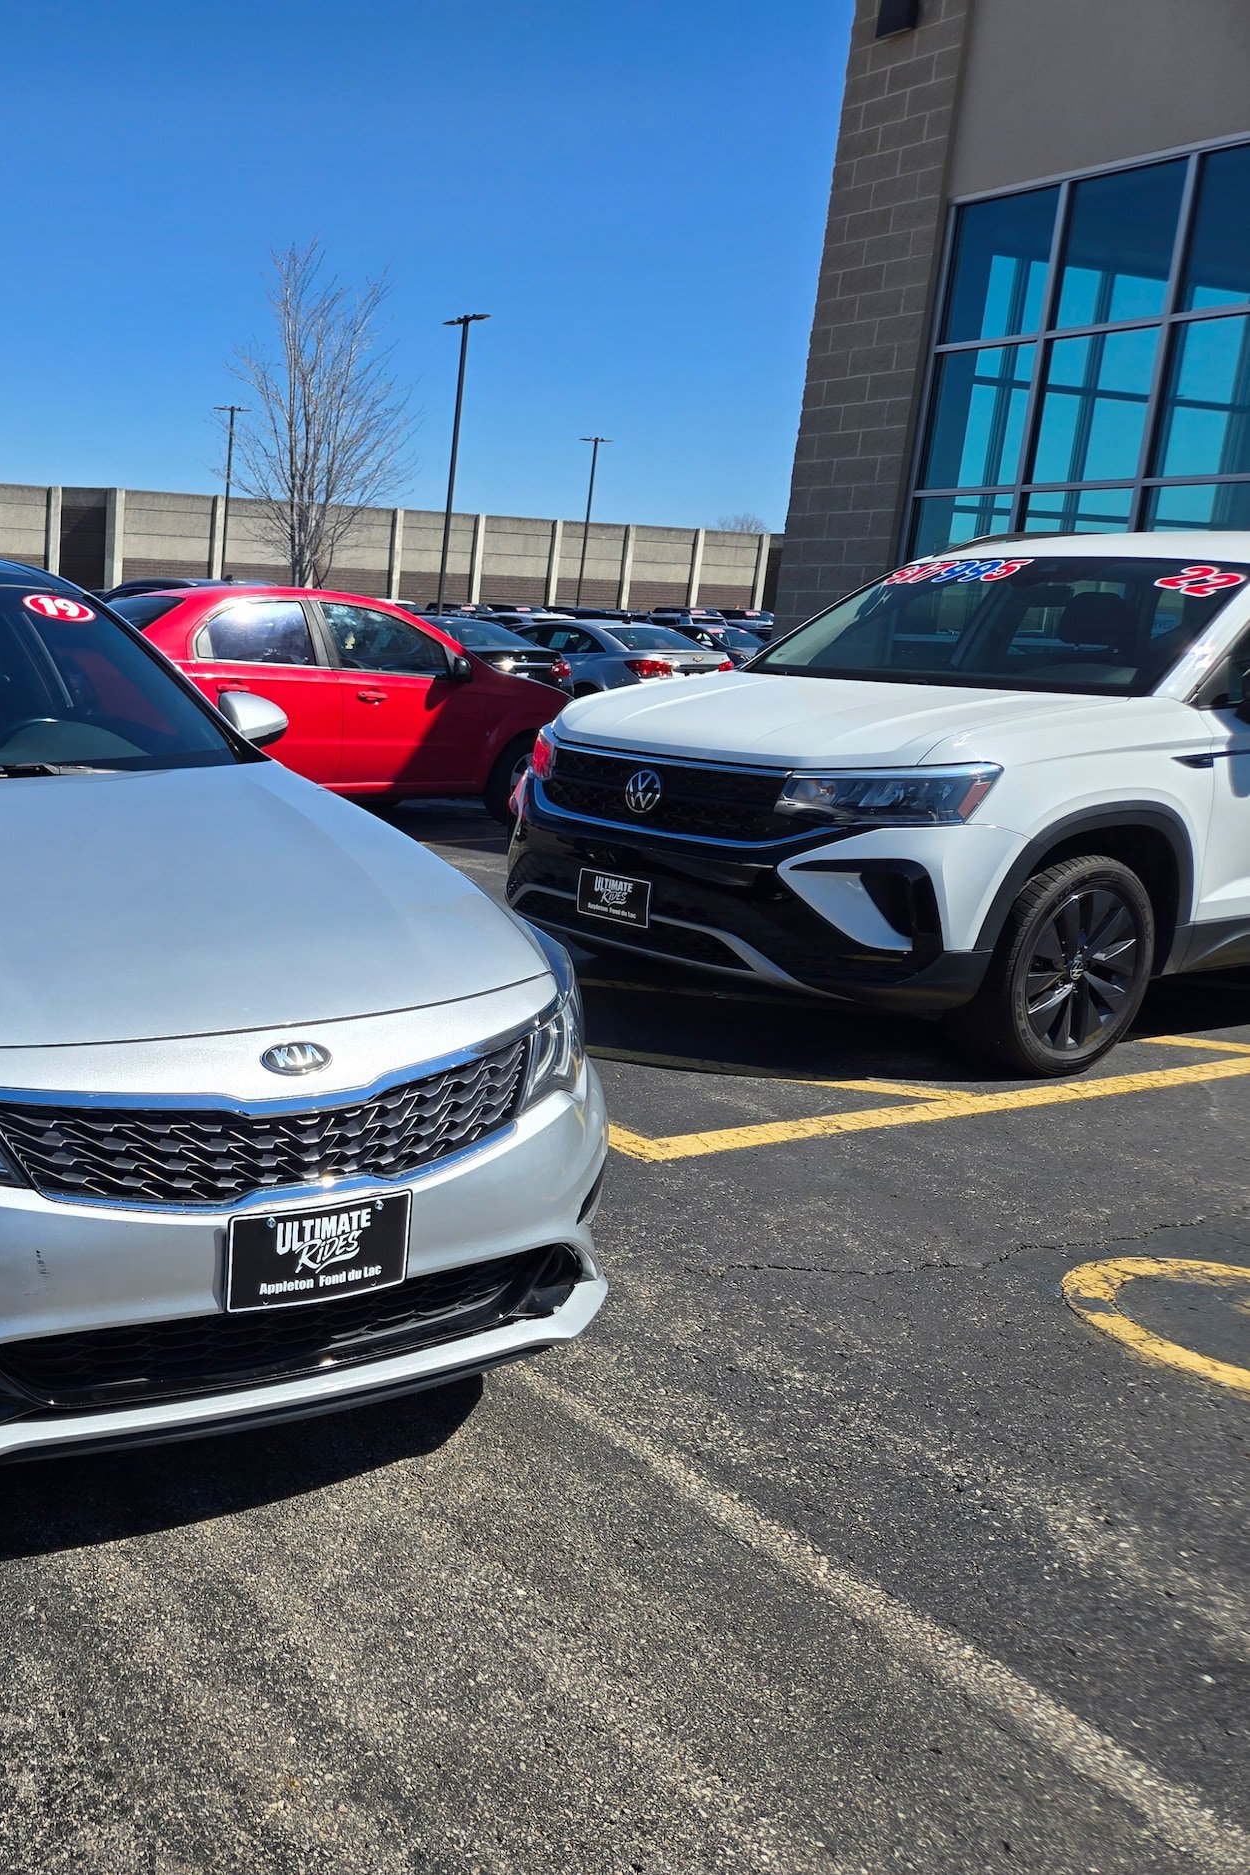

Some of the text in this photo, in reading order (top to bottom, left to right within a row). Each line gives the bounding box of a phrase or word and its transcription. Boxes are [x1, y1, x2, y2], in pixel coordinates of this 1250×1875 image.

[1153, 565, 1248, 597] 22
[37, 597, 81, 617] 19
[594, 876, 634, 893] ULTIMATE
[271, 1045, 325, 1068] KIA
[276, 1208, 372, 1255] ULTIMATE
[259, 1264, 382, 1295] Appleton Fond du Lac
